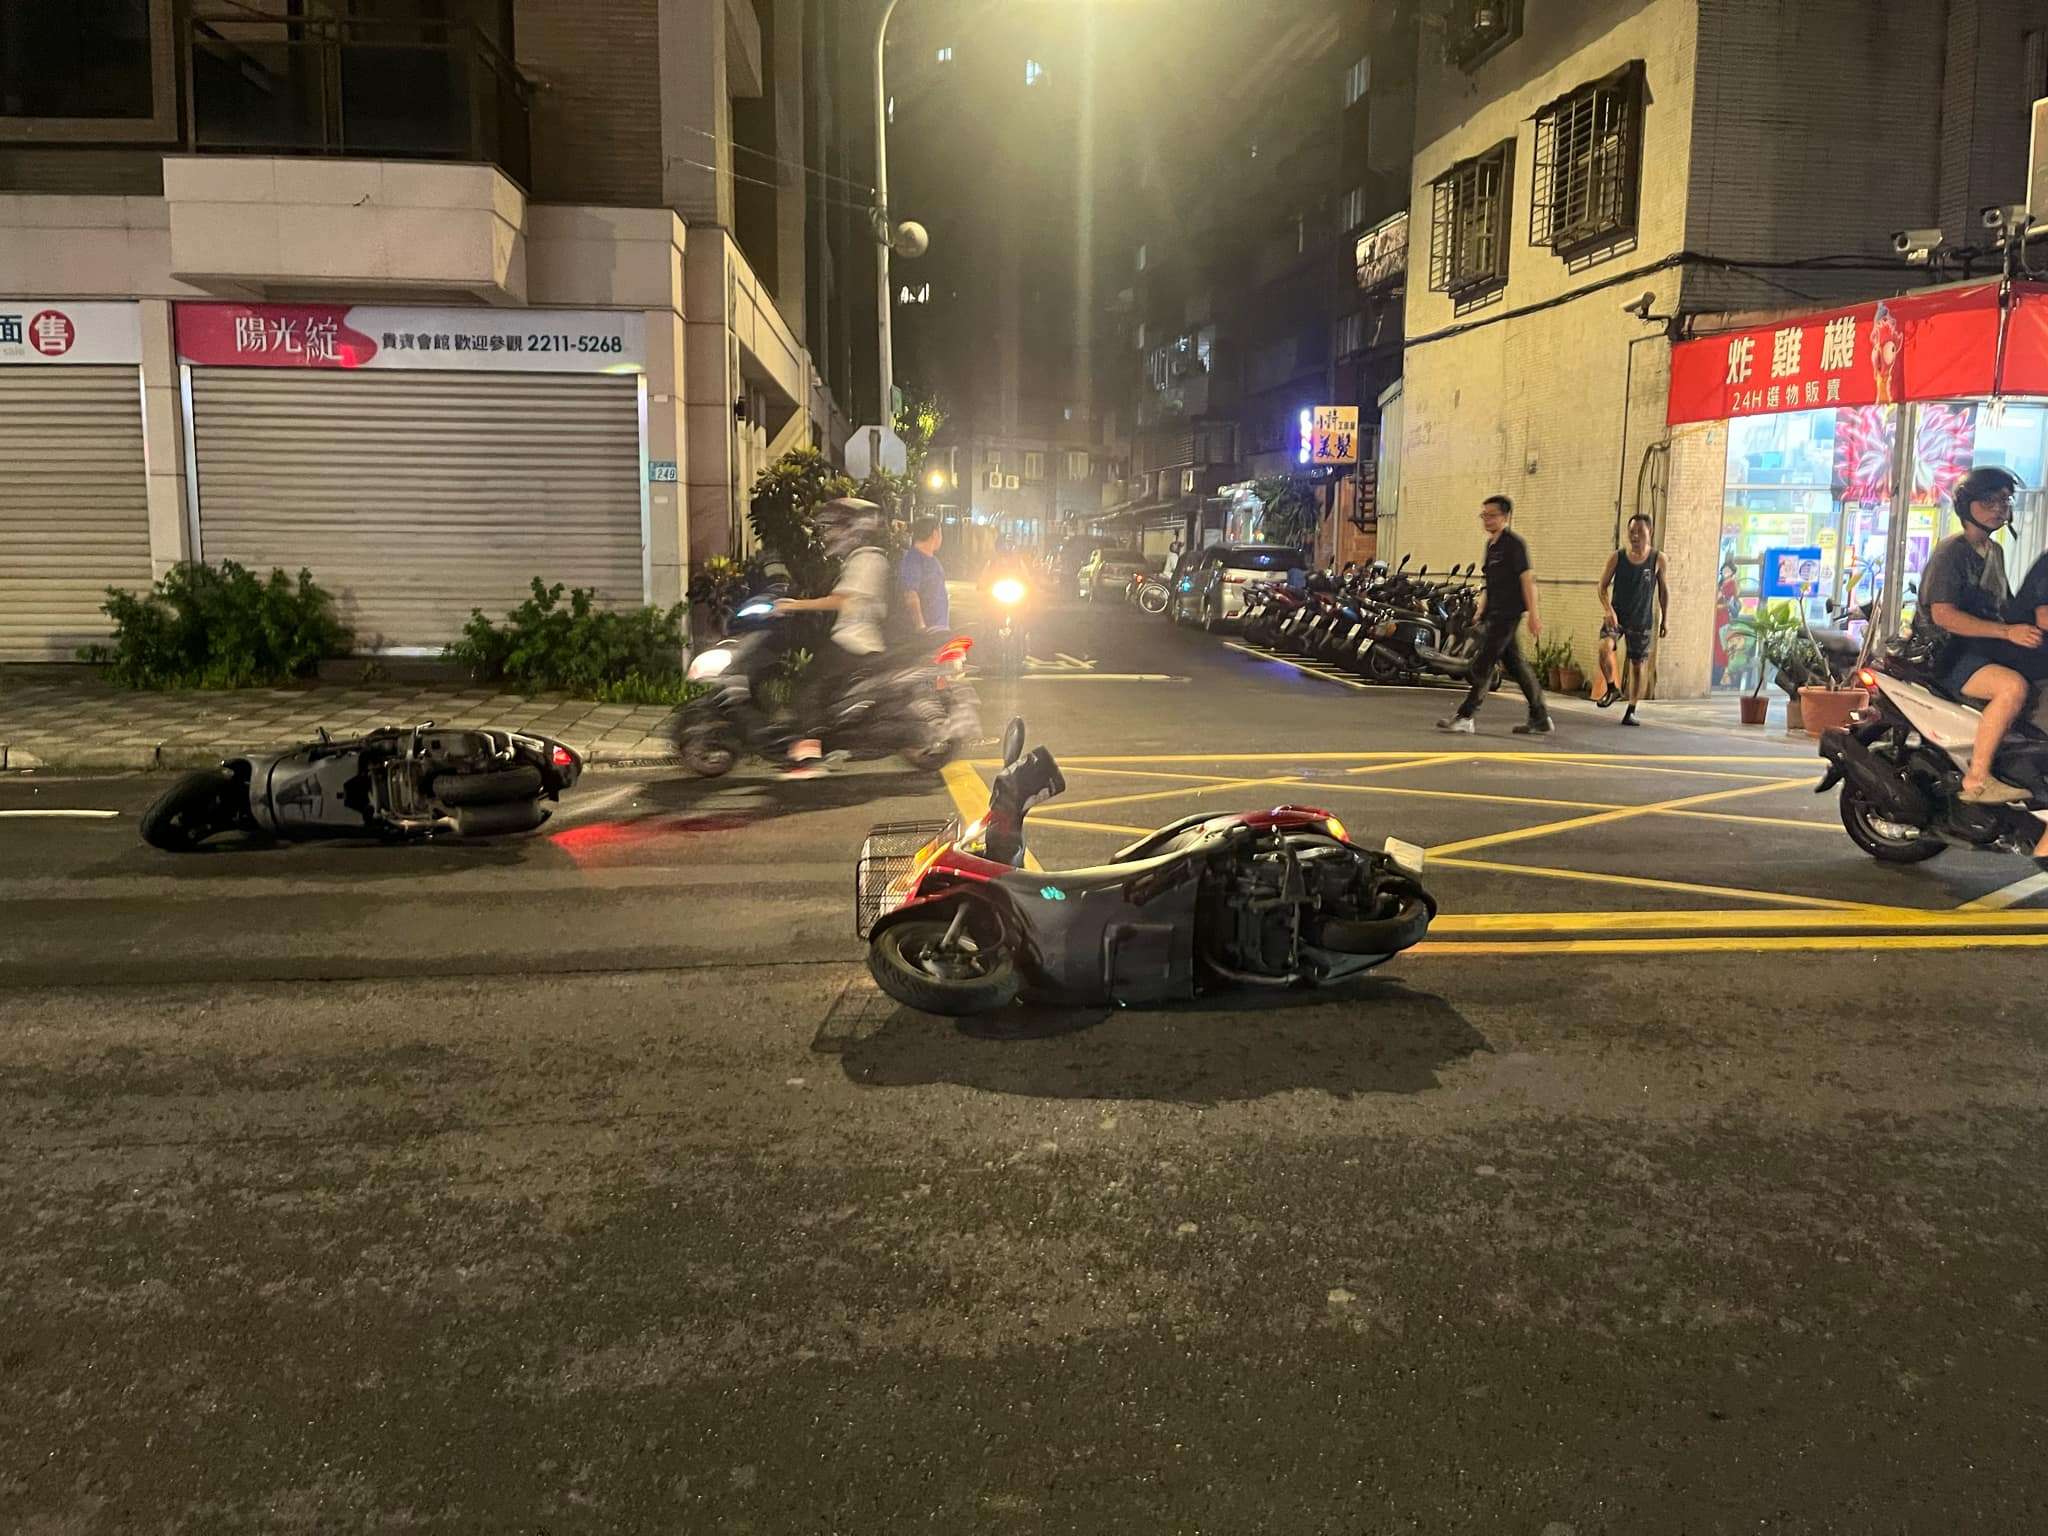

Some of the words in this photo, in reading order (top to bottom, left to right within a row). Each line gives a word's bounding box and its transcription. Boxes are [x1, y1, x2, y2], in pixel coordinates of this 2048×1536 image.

[235, 316, 343, 364] 陽光綻
[454, 334, 523, 351] 歡迎參觀
[527, 334, 622, 352] 2211-5268
[1726, 316, 1856, 384] 炸雞機
